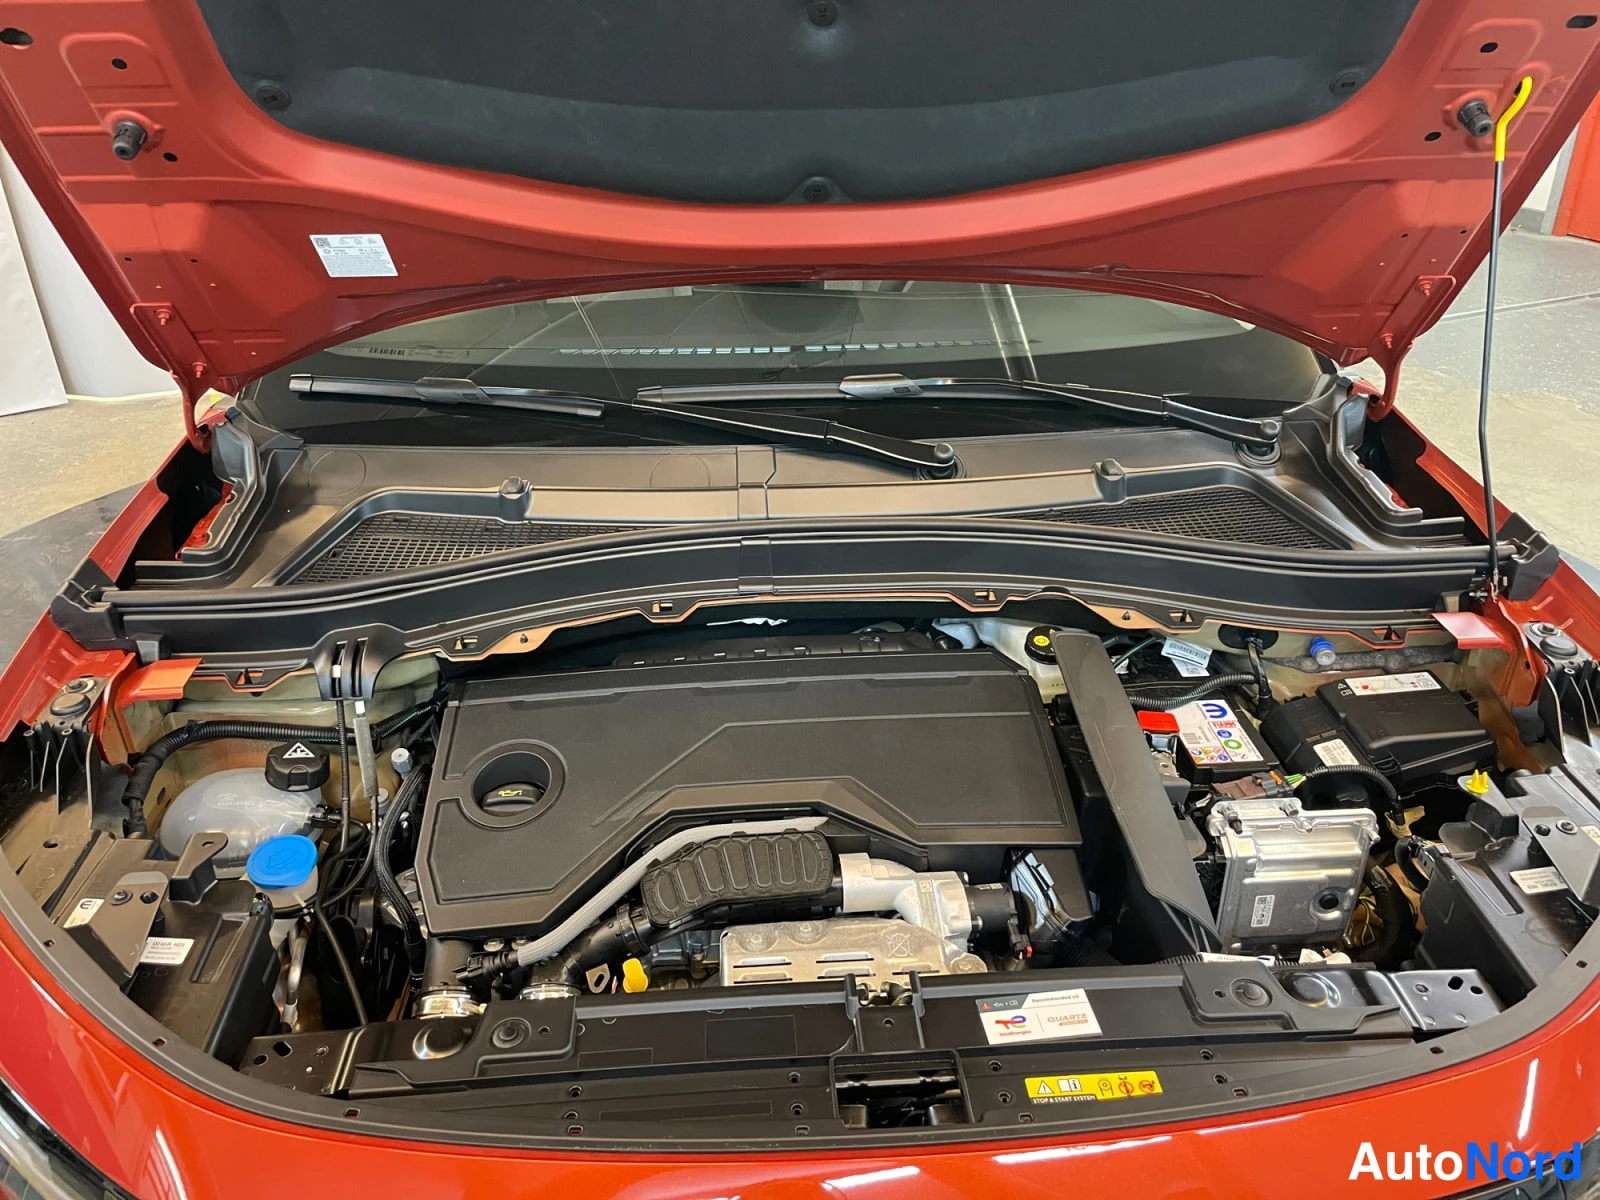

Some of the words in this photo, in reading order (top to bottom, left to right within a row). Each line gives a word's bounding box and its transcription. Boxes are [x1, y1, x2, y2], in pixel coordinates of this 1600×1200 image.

[1212, 720, 1237, 729] FIAMM
[1047, 1013, 1088, 1023] QUARTZ
[1032, 1096, 1049, 1104] STOP
[1055, 1095, 1072, 1103] START
[1072, 1094, 1096, 1102] SYSTEM
